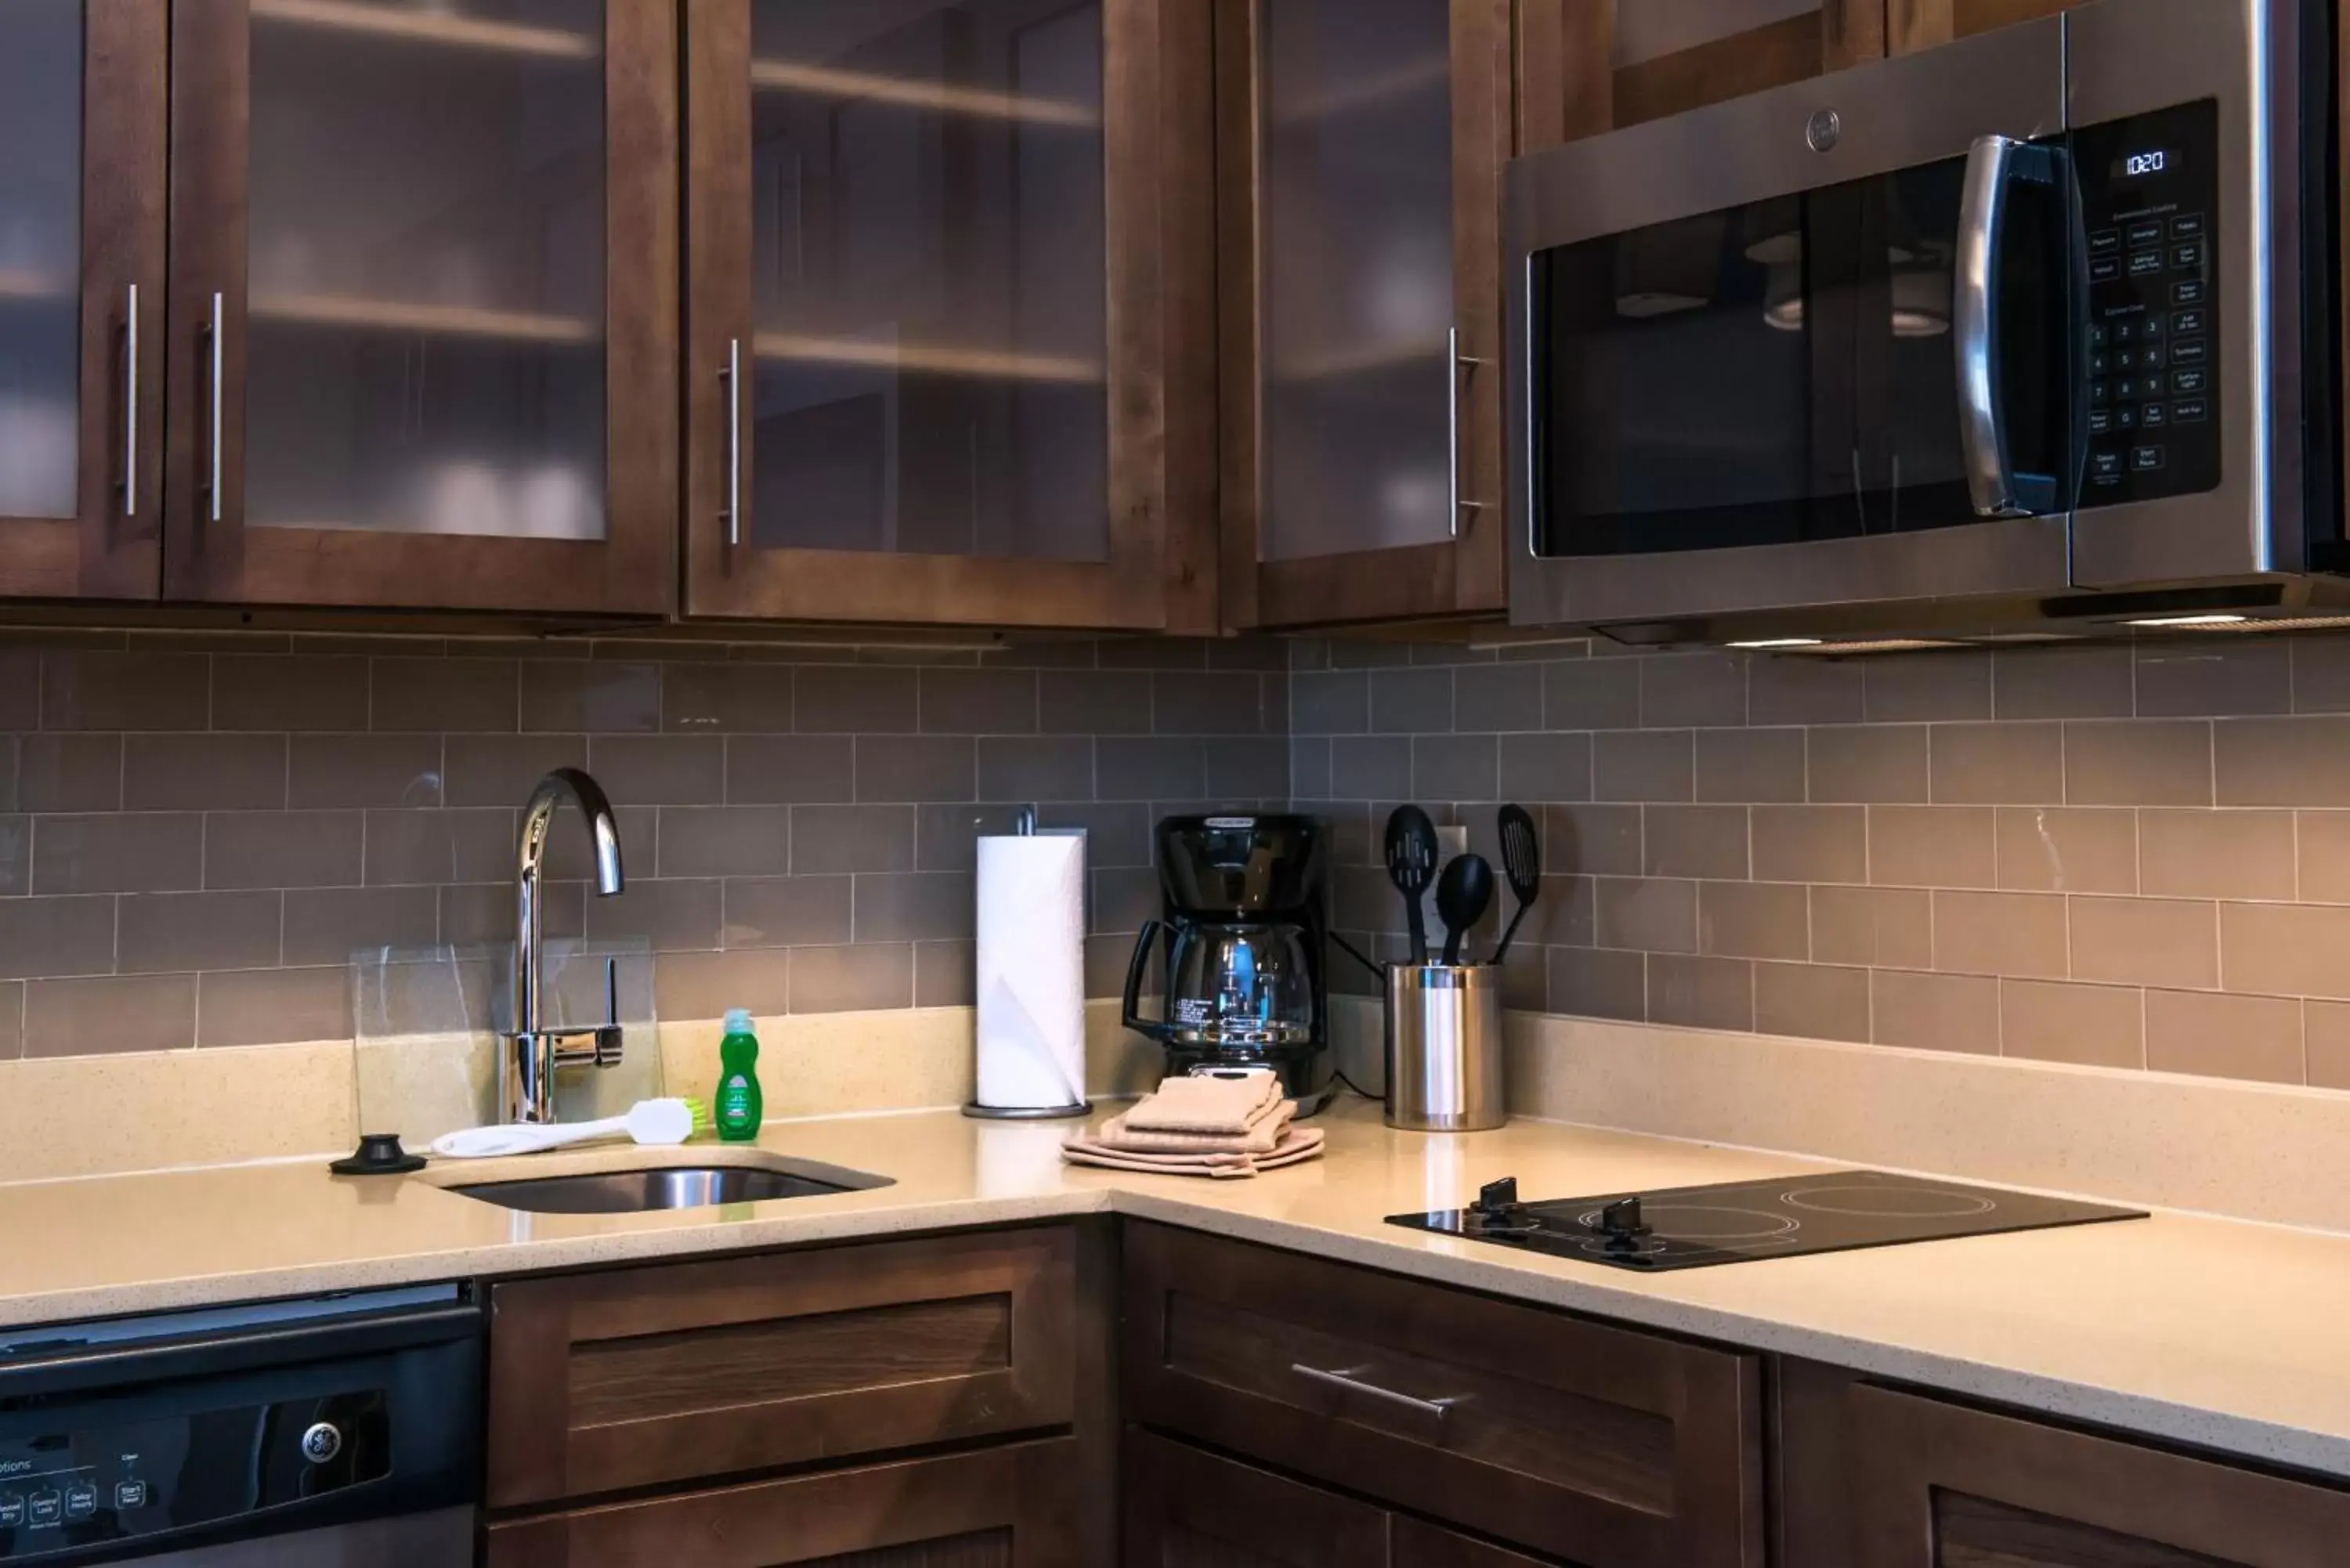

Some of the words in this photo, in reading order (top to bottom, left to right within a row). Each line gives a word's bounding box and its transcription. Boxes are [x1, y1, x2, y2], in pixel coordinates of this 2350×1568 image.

[2127, 151, 2163, 175] 10:20
[2121, 326, 2129, 337] 2
[2149, 321, 2157, 332] 3
[2121, 355, 2129, 365] 5
[2095, 387, 2102, 397] 7
[2122, 382, 2129, 393] 8
[2149, 379, 2157, 390] 9
